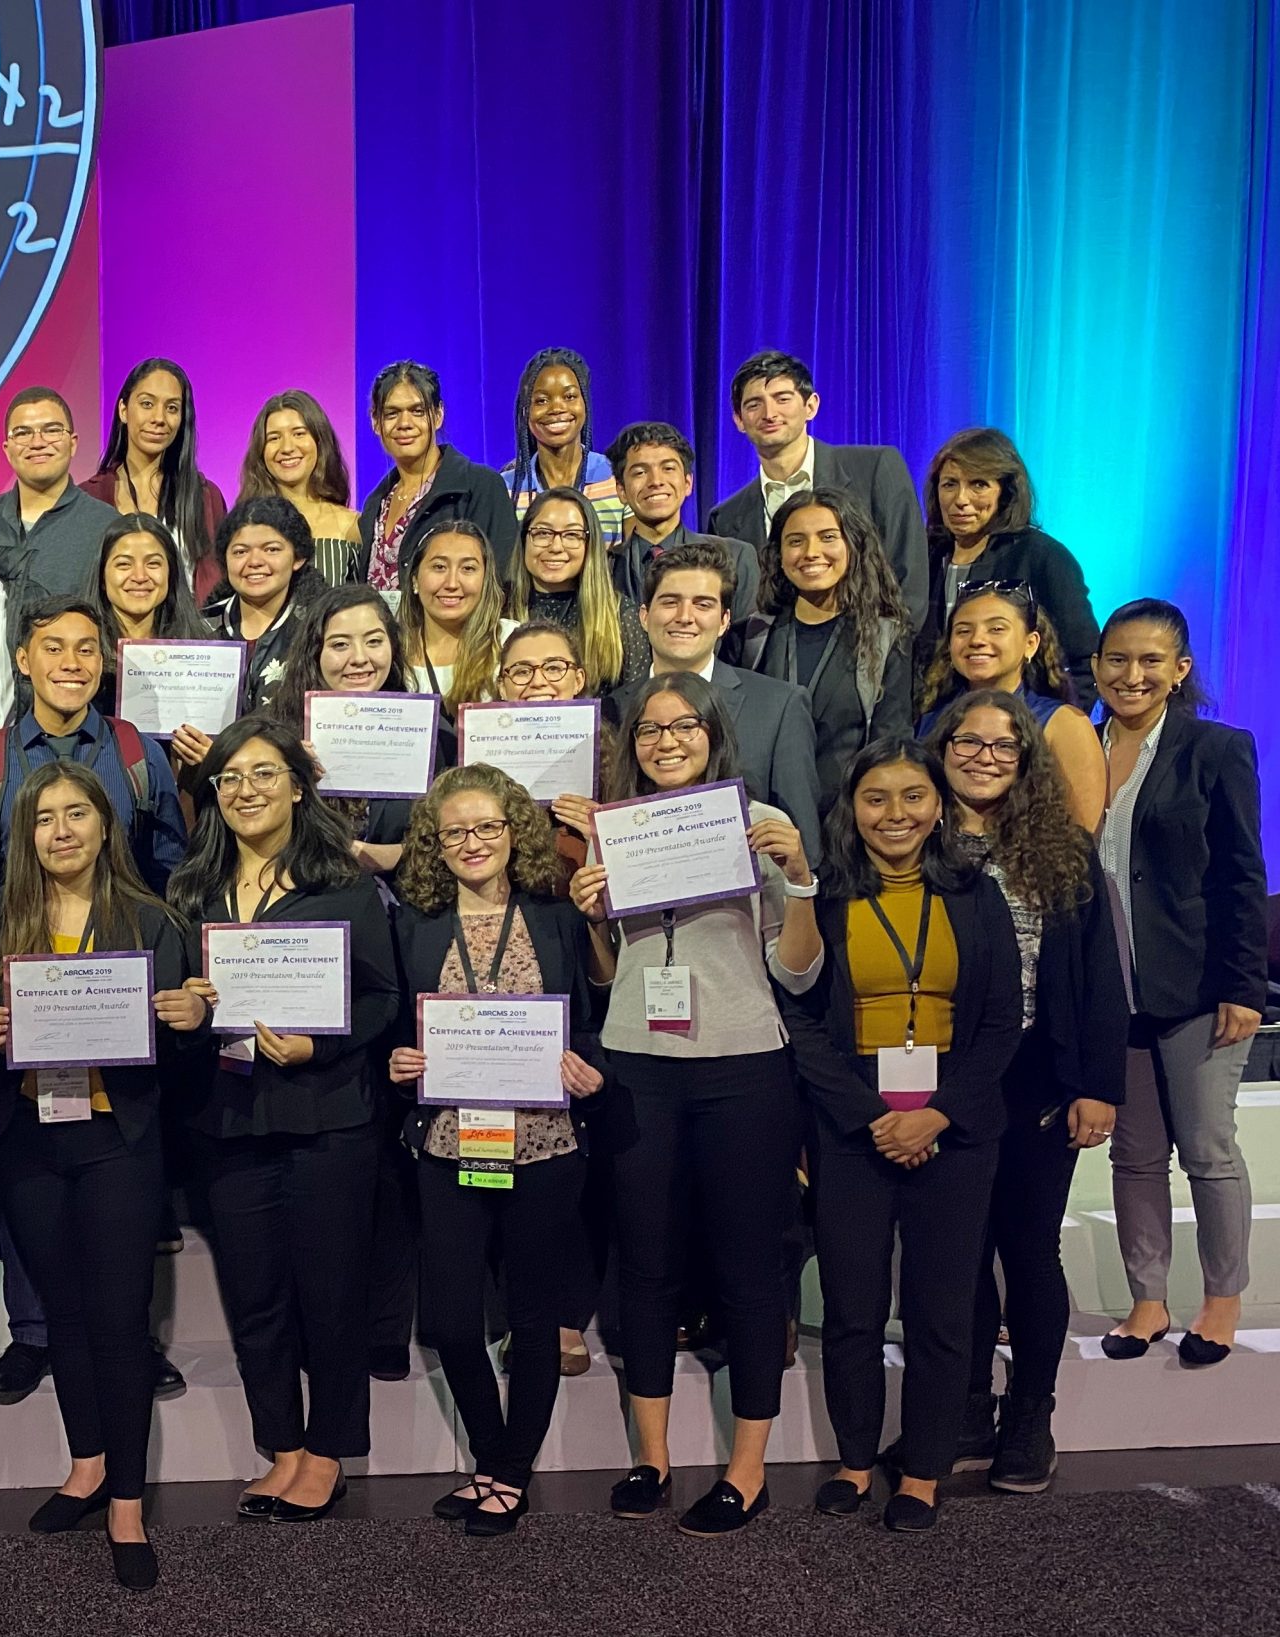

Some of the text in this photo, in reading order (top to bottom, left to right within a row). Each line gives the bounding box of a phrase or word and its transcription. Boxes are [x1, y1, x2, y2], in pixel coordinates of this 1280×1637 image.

[316, 723, 362, 731] CERTIFICATE
[378, 724, 428, 732] ACHIEVEMENT
[684, 803, 702, 811] 2019
[606, 831, 659, 846] CERTIFICATE
[677, 816, 737, 833] ACHIEVEMENT
[625, 849, 644, 859] 2019
[644, 841, 691, 855] Presentation
[282, 956, 338, 964] ACHIEVEMENT
[230, 972, 248, 980] 2019
[249, 971, 292, 979] Presentation
[86, 986, 142, 994] ACHIEVEMENT
[53, 1003, 96, 1011] Presentation
[429, 1027, 481, 1035] CERTIFICATE
[499, 1028, 558, 1036] ACHIEVEMENT
[465, 1043, 509, 1051] Presentation
[460, 1160, 511, 1171] Superstar
